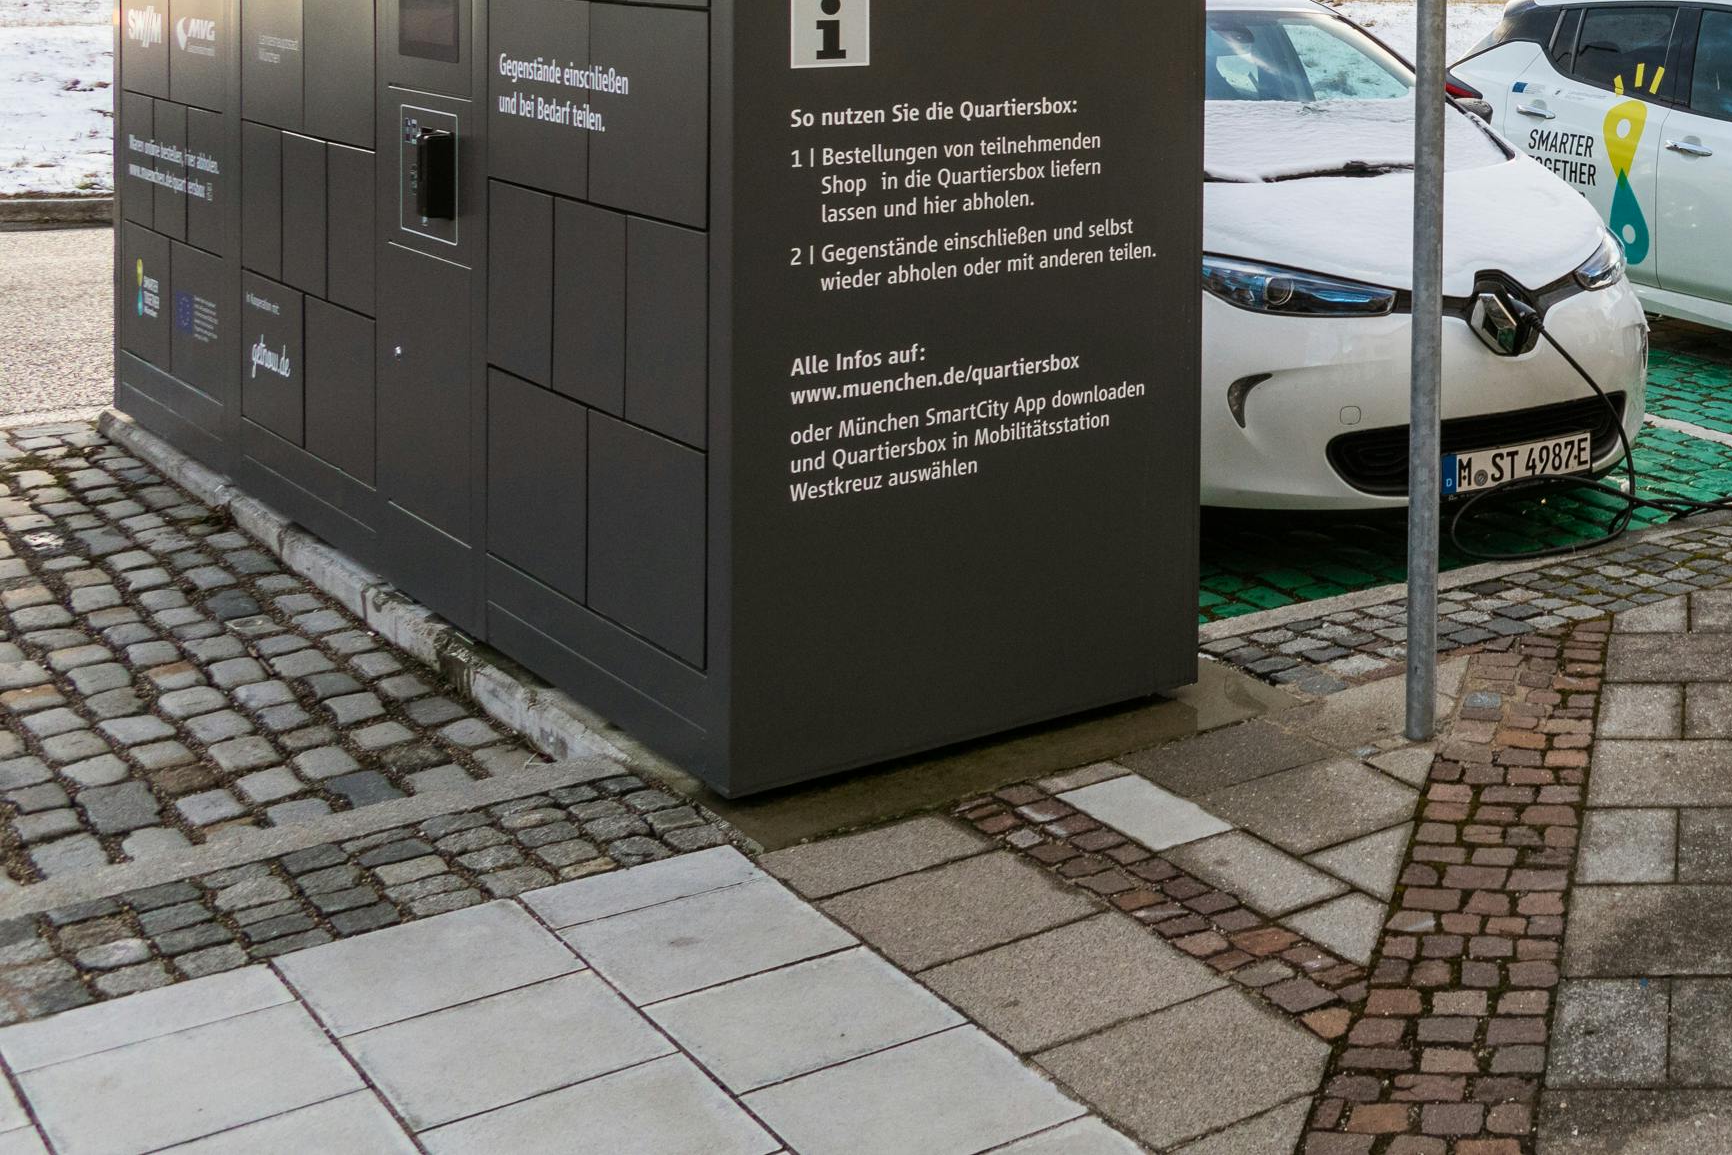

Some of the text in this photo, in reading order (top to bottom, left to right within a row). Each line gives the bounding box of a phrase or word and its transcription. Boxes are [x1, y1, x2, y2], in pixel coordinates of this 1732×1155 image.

[187, 18, 215, 40] MVG
[499, 53, 629, 95] Gegenstände einschließen
[499, 91, 605, 133] und bei Bedarf teilen.
[791, 97, 1077, 127] So nutzen Sie die Quartiersbox:
[823, 144, 937, 168] Bestellungen
[944, 144, 973, 157] von
[980, 132, 1100, 155] teilnehmenden
[1528, 128, 1594, 158] SMARTER
[822, 159, 1101, 196] Shop in die Quartiersbox liefern
[822, 190, 1034, 223] lassen und hier abholen.
[822, 235, 938, 265] Gegenstände
[944, 226, 1047, 251] einschließen
[1054, 221, 1082, 240] und
[1089, 218, 1133, 237] selbst
[821, 242, 1156, 291] wieder abholen oder mit anderen teilen.
[252, 334, 291, 378] getnow.de
[791, 343, 925, 376] Alle Infos auf:
[791, 354, 1079, 404] www.muenchen.de/quartiersbox
[791, 381, 1144, 444] oder München SmartCity App downloaden
[791, 412, 1109, 473] und Quartiersbox in Mobilitätsstation
[790, 459, 977, 501] Westkreuz auswählen
[1458, 457, 1472, 487] M
[1491, 450, 1519, 483] ST
